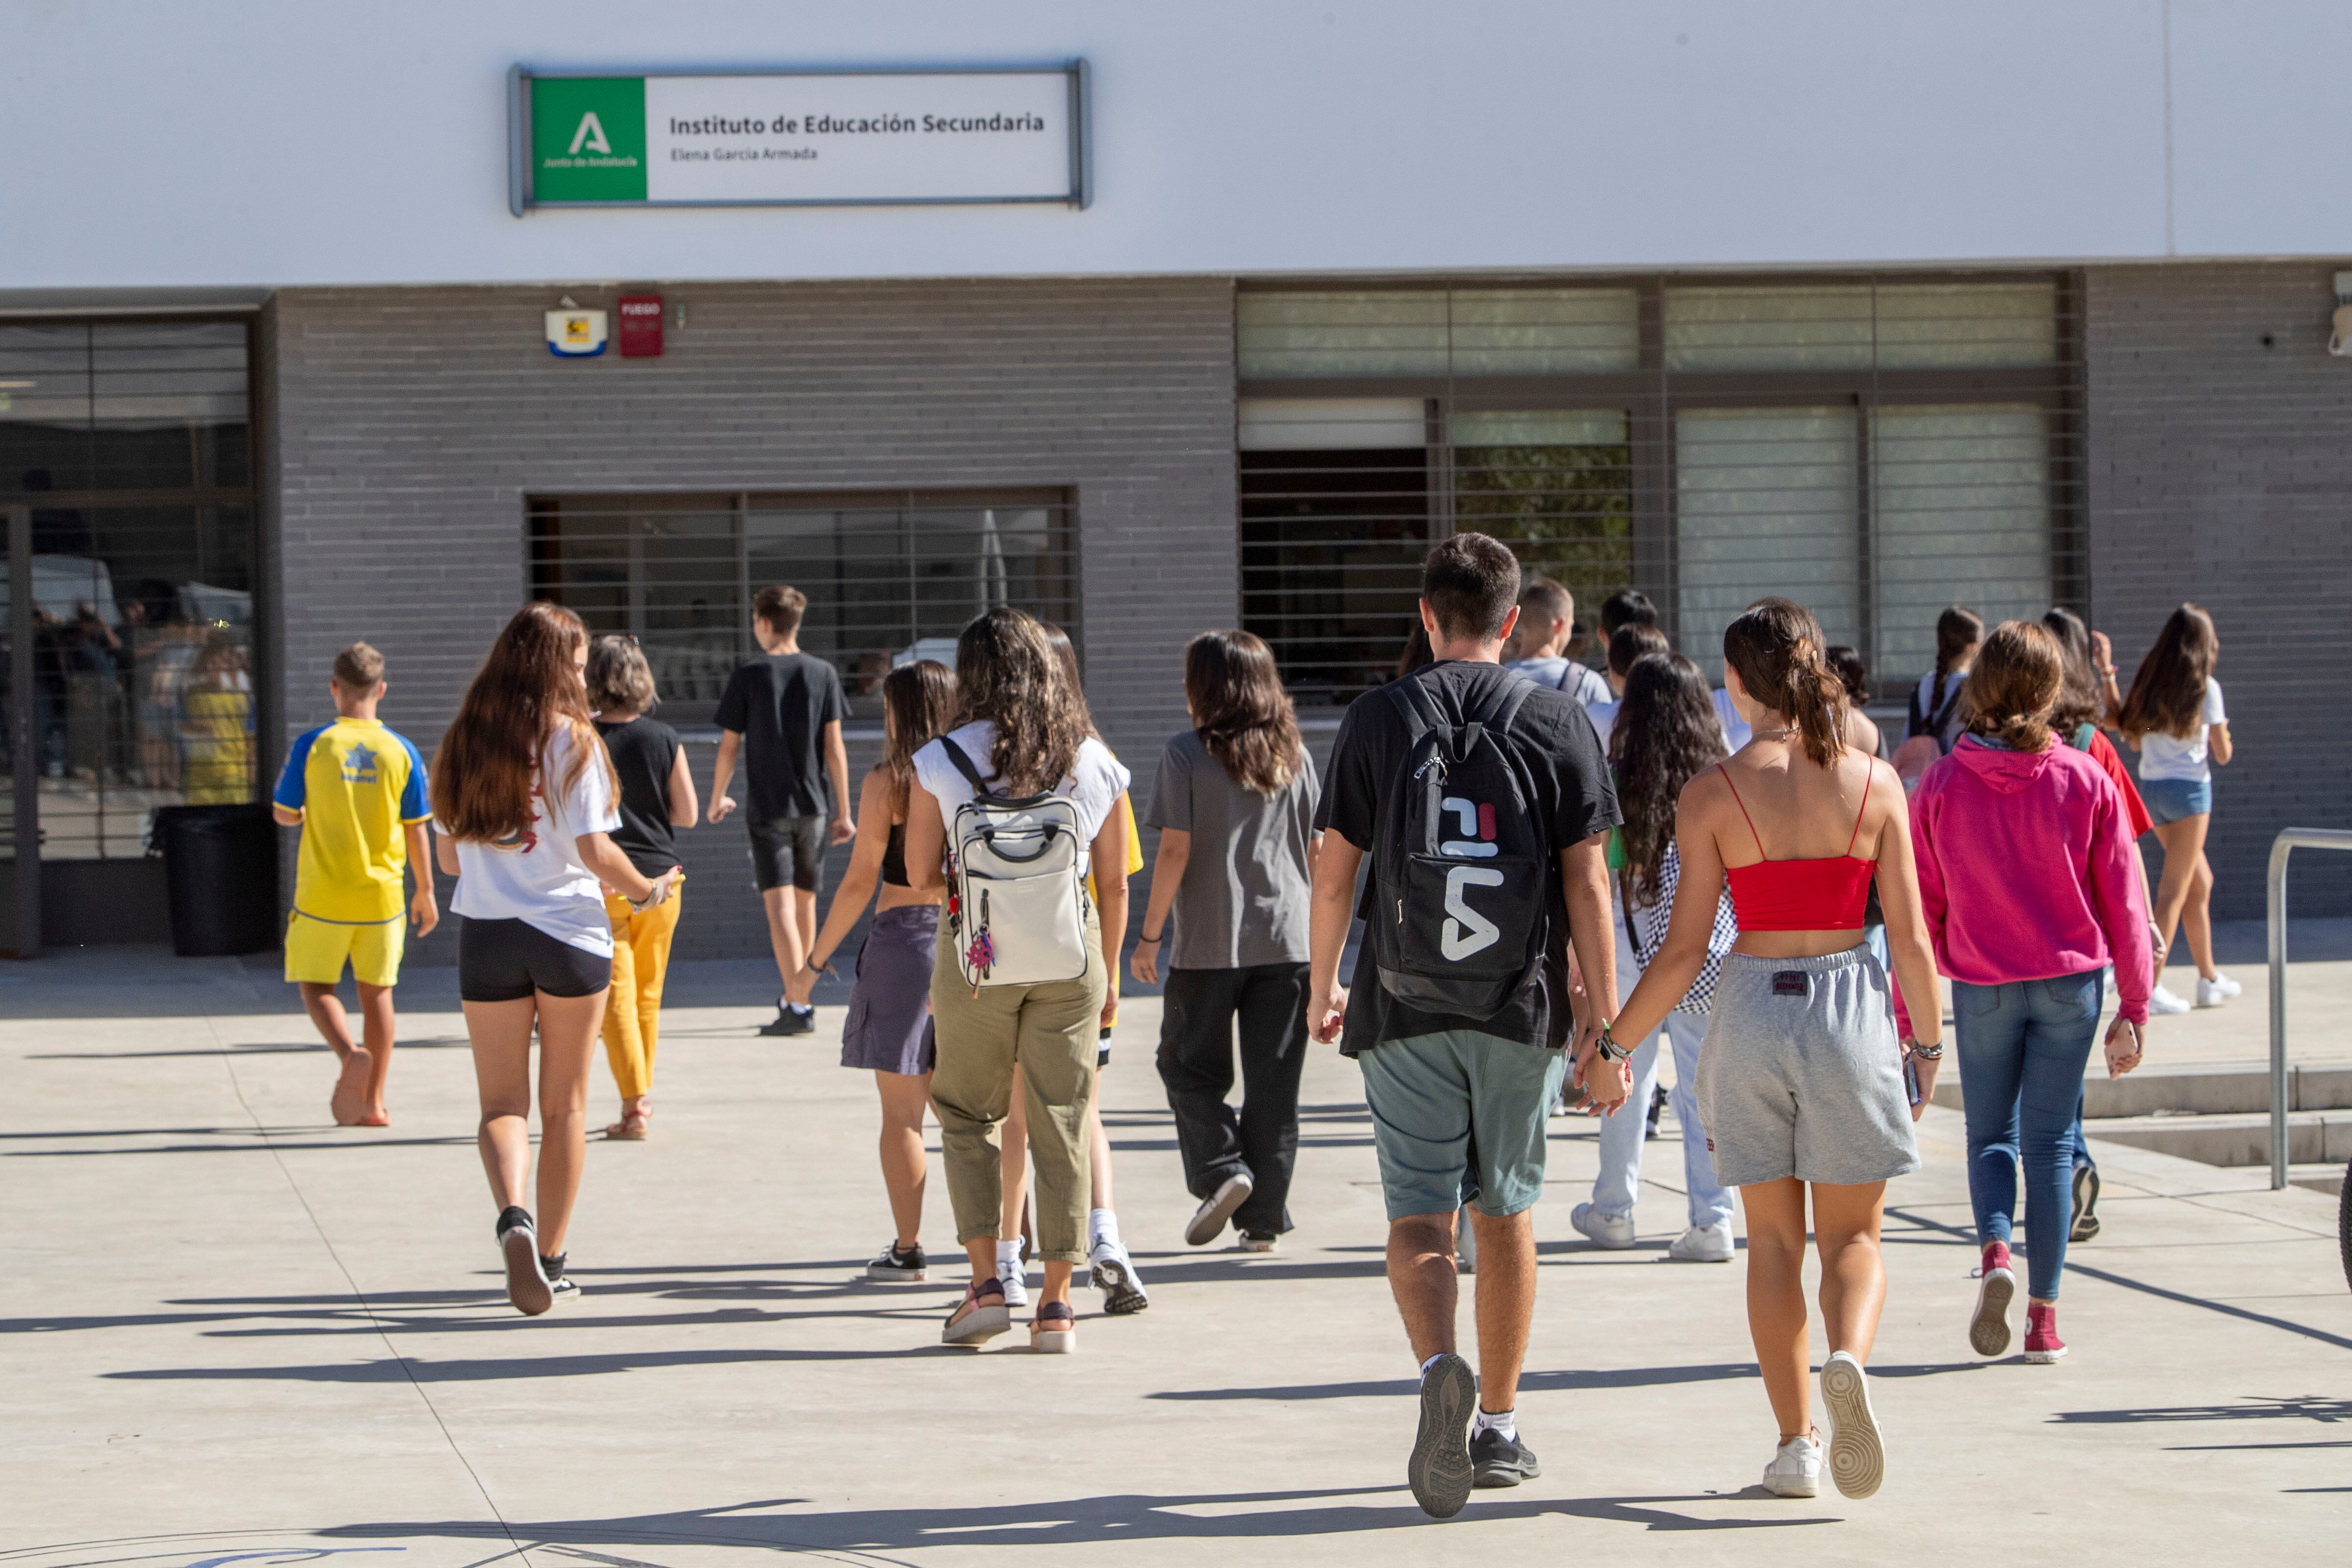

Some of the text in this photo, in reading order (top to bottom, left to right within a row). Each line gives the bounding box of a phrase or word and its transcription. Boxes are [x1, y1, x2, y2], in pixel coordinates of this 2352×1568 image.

[669, 111, 1046, 135] Instituto de Educación Secundaria
[670, 148, 711, 162] Elena
[761, 146, 818, 161] Armada
[1441, 796, 1504, 961] FILA
